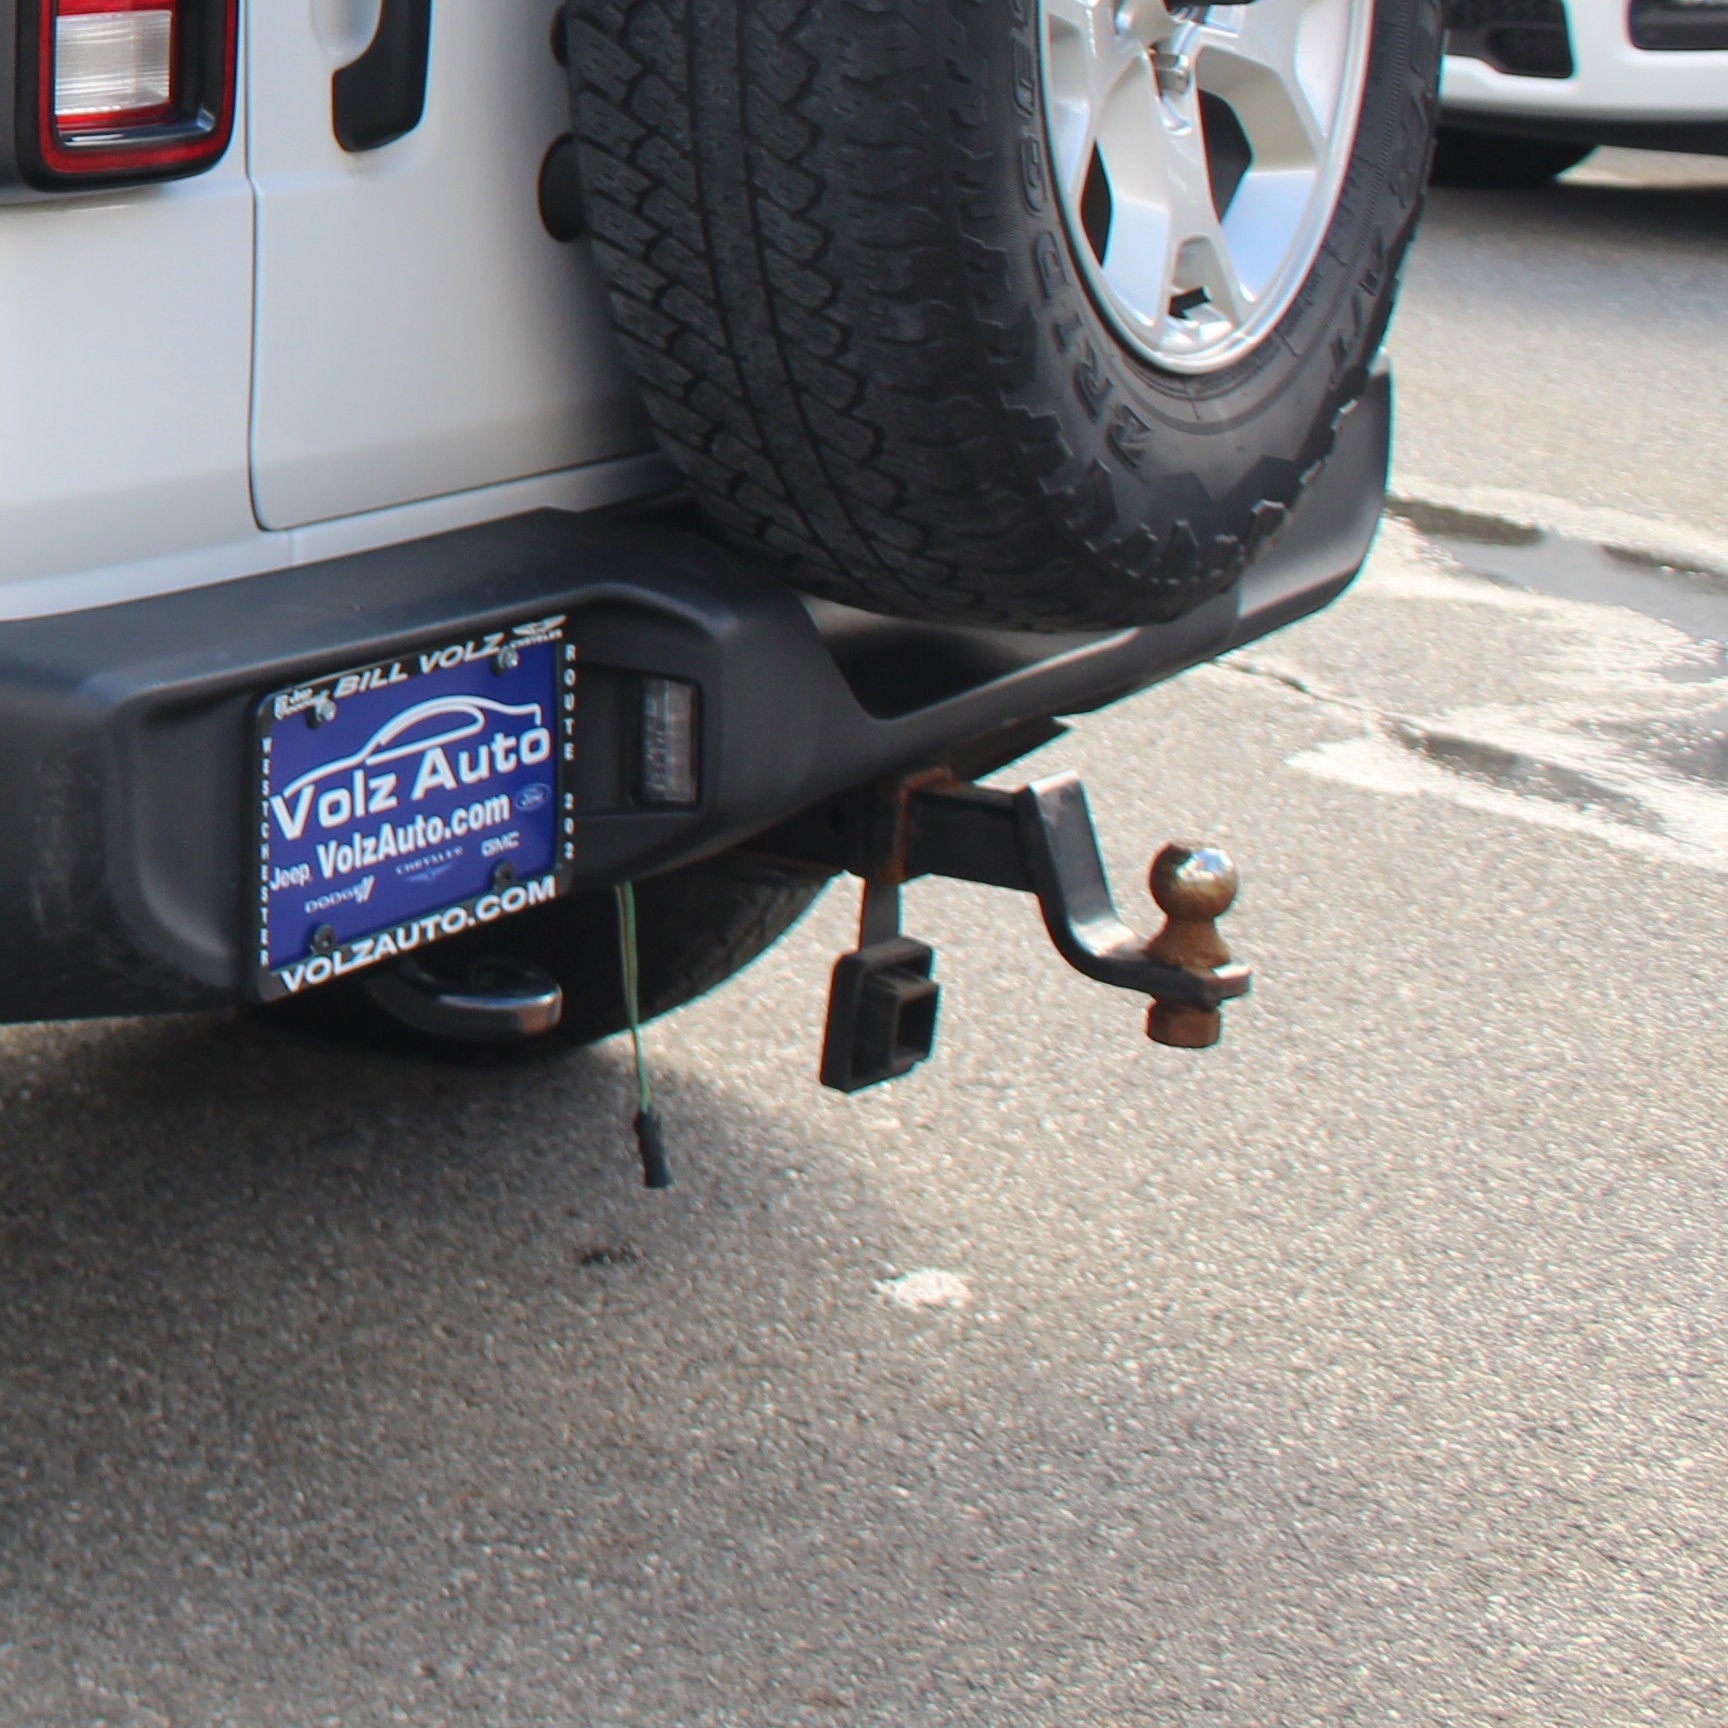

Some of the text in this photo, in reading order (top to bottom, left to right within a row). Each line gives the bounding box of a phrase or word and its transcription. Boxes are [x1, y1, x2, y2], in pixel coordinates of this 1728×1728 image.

[333, 632, 505, 699] BILL VOLZ
[270, 727, 550, 841] Volz Auto
[316, 794, 511, 880] VolzAuto.com
[480, 831, 520, 857] GMC
[268, 863, 312, 891] Jeep
[281, 875, 557, 992] VOLZAUTO.COM
